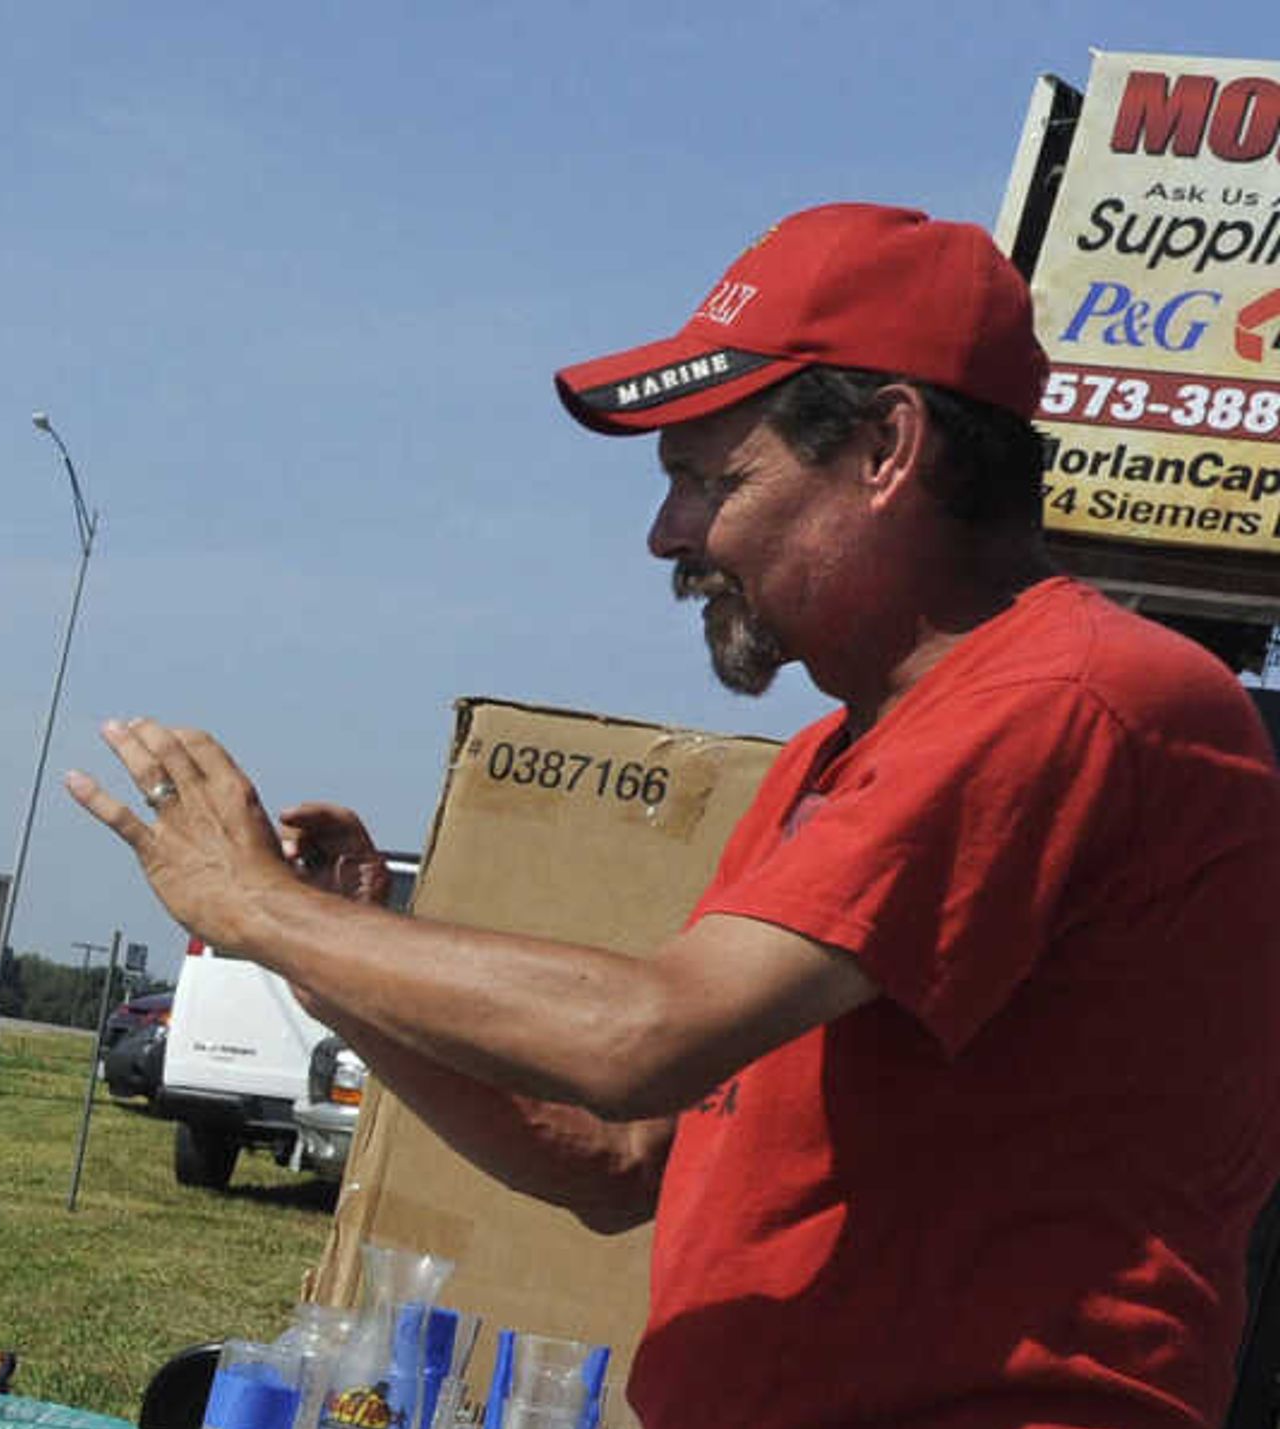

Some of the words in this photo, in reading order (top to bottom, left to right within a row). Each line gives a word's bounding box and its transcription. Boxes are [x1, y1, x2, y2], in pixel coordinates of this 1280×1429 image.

[1109, 70, 1280, 163] MO
[1145, 182, 1206, 203] Ask
[1222, 187, 1260, 206] Us
[1059, 281, 1223, 351] P&G
[616, 352, 730, 406] MARINE
[1040, 372, 1280, 434] 573-388
[1087, 490, 1262, 536] Siemers
[488, 742, 669, 805] 0387166
